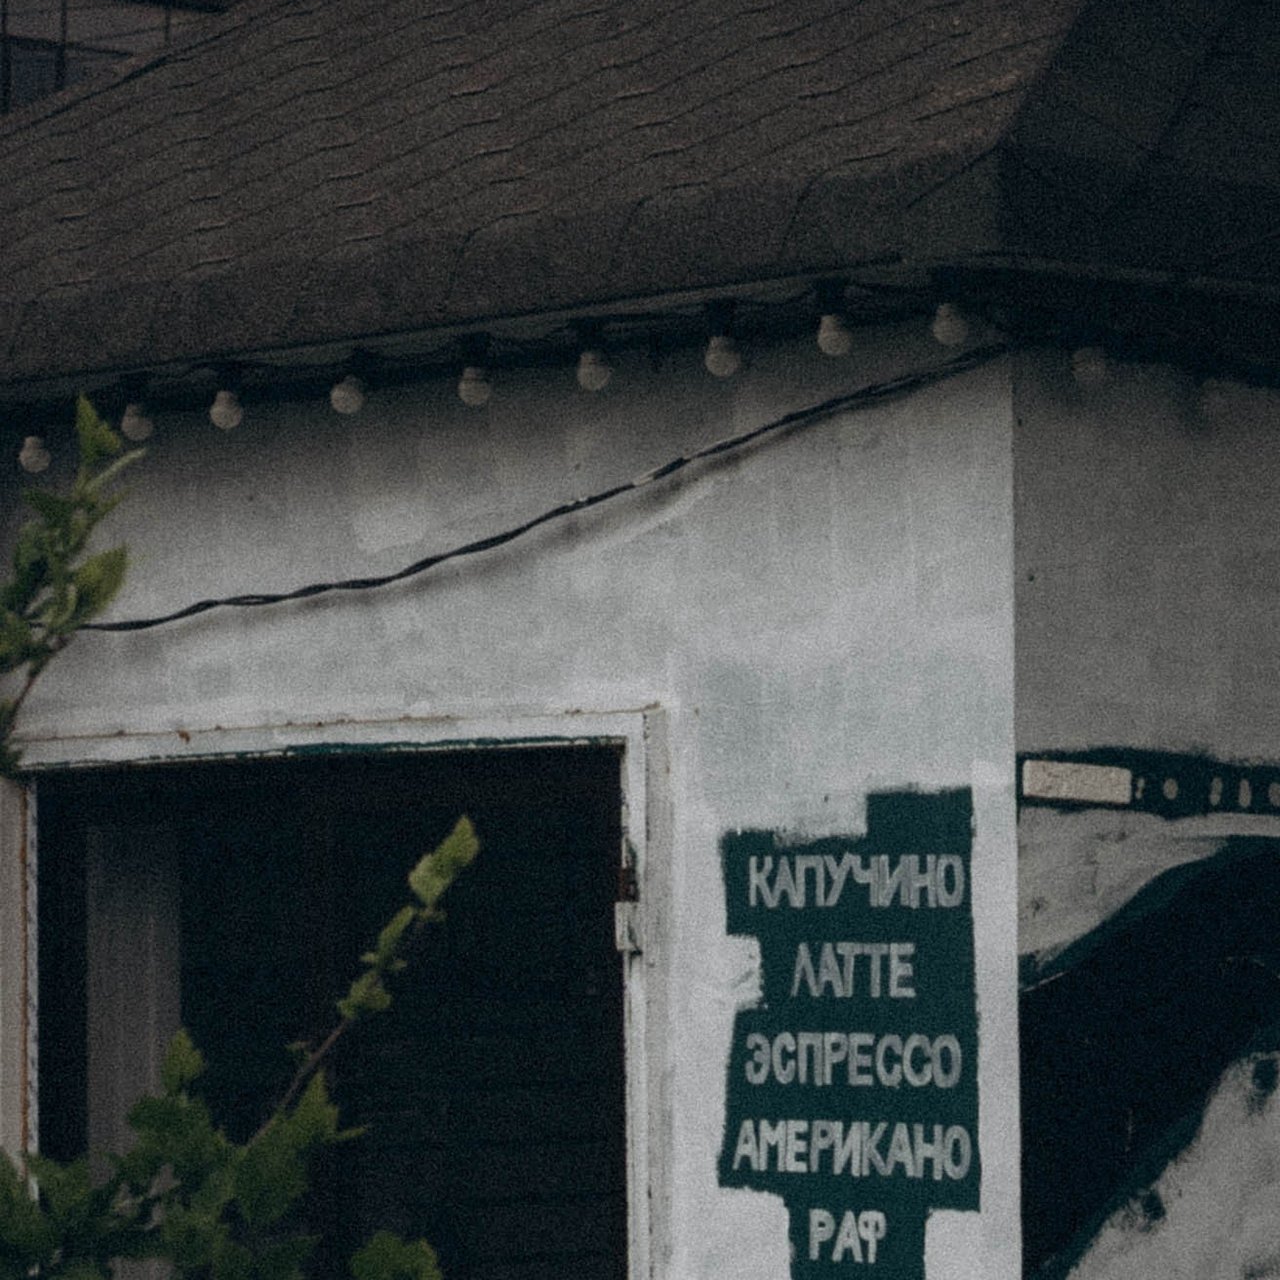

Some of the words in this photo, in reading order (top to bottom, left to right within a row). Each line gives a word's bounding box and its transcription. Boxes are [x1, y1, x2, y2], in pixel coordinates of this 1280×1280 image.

[748, 851, 965, 909] КАПУЧИНО
[790, 942, 916, 999] ЛАТТЕ
[745, 1031, 962, 1089] ЭСПРЕССО
[733, 1119, 972, 1180] АМЕРИКАНО
[808, 1209, 887, 1263] РАФ
